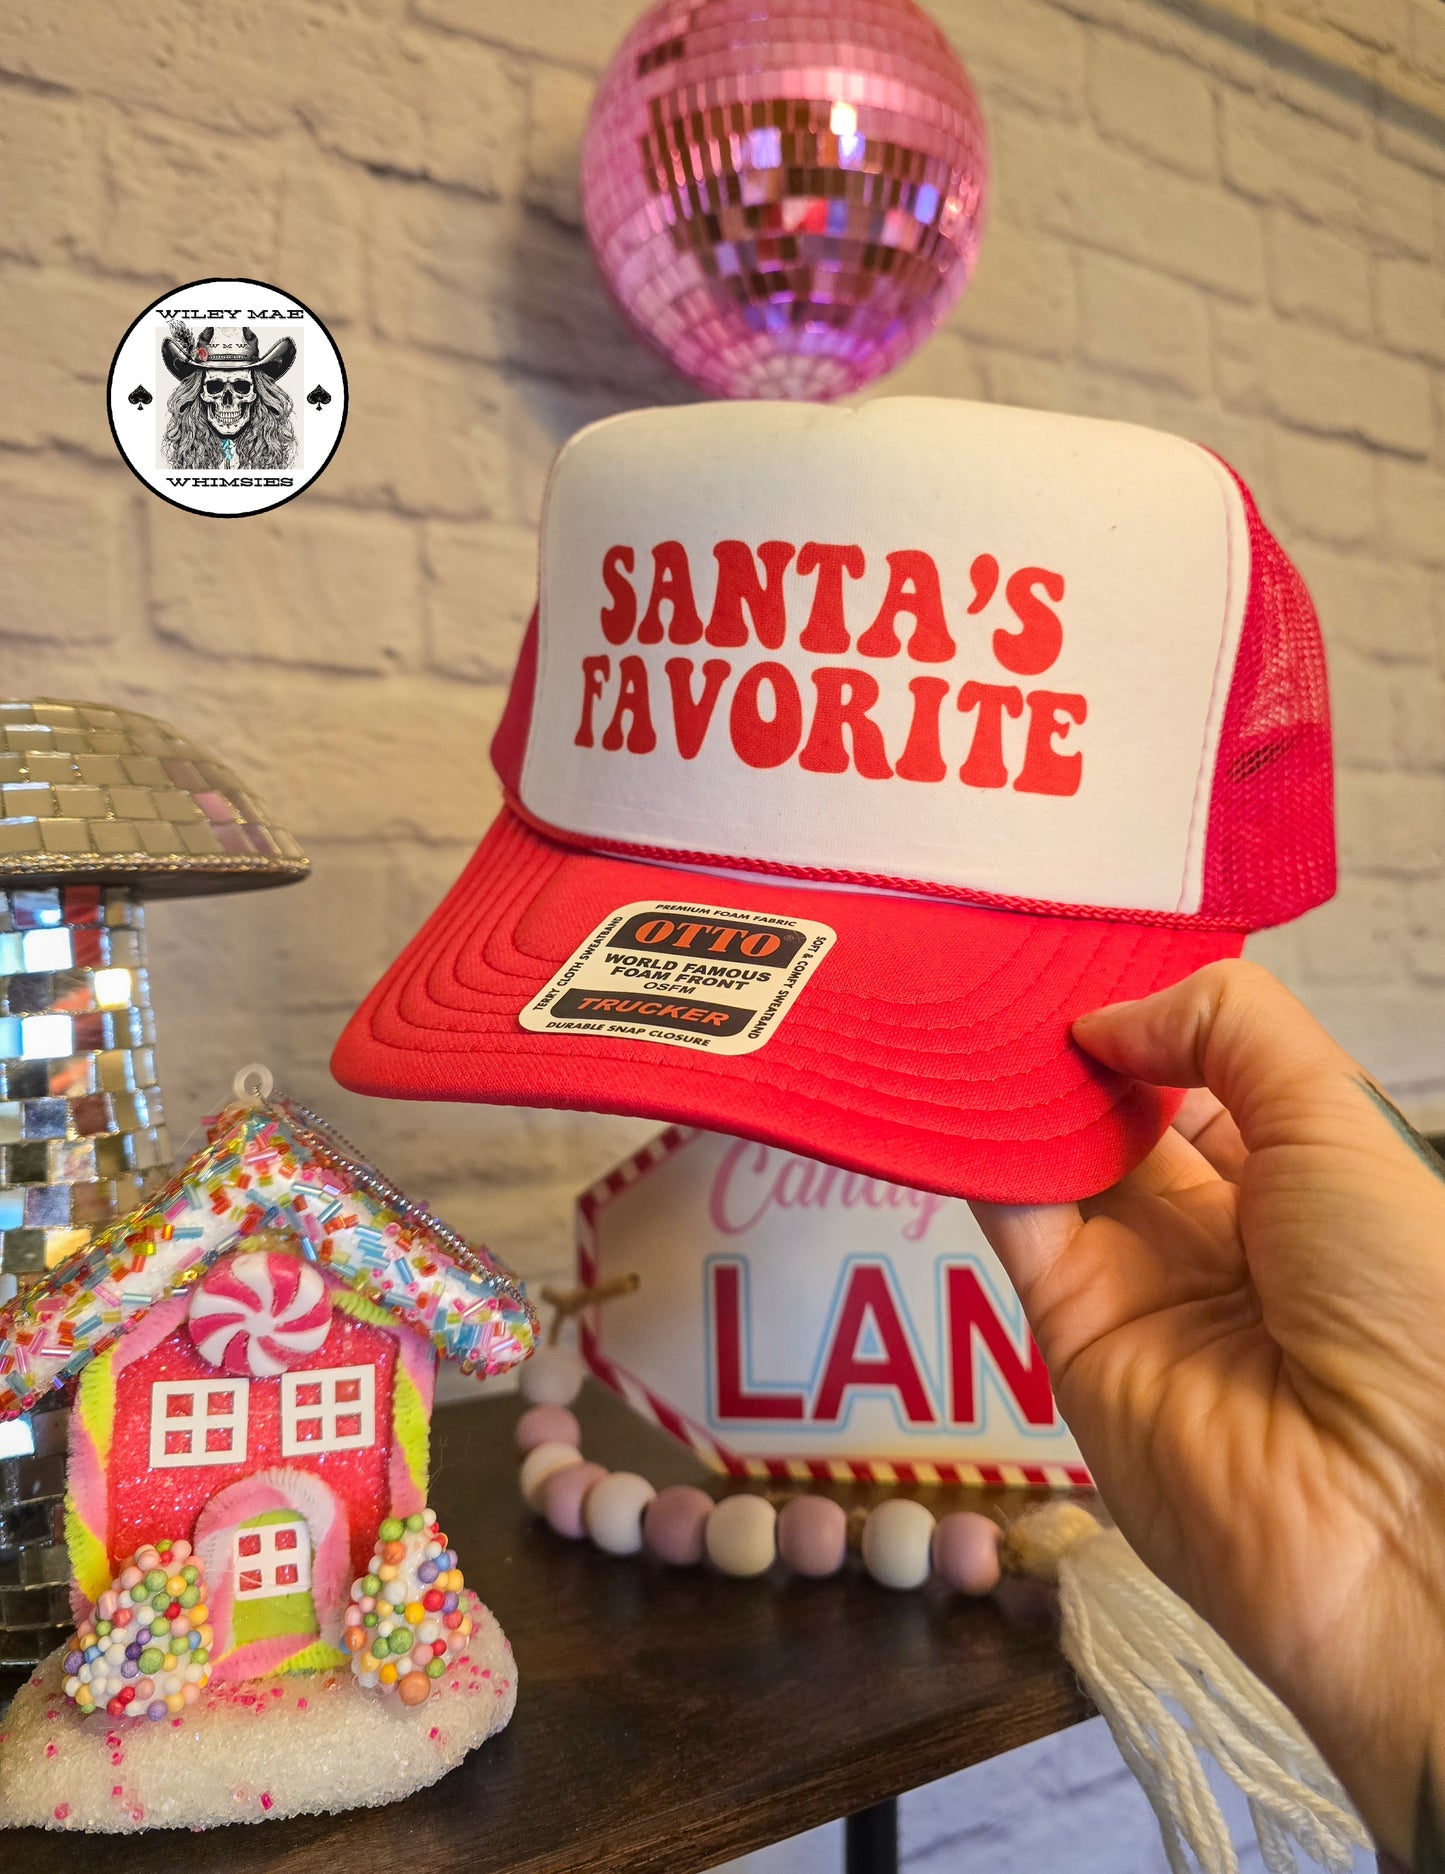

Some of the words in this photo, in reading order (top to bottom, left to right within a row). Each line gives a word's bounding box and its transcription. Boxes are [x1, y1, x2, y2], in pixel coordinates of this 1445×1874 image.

[600, 539, 1065, 676] SANTA'S
[573, 654, 1088, 797] FAVORITE
[655, 903, 711, 915] PREMIUM
[713, 910, 750, 920] FOAM
[753, 915, 797, 928] FABRIC
[634, 919, 781, 958] OTTO
[807, 936, 827, 953] SOFT
[532, 987, 560, 1011] TERRY
[556, 962, 584, 987] CLOTH
[579, 916, 624, 960] SWEATBAND
[604, 953, 679, 970] WORLD
[682, 963, 772, 982] FAMOUS
[783, 960, 808, 988] COMFY
[610, 966, 671, 981] FOAM
[674, 974, 750, 991] FRONT
[643, 981, 697, 994] OSFM
[577, 997, 730, 1027] TRUCKER
[747, 989, 790, 1039] SWEATBAND
[545, 1021, 605, 1031] DURABLE
[606, 1024, 646, 1035] SNAP
[649, 1030, 712, 1047] CLOSURE
